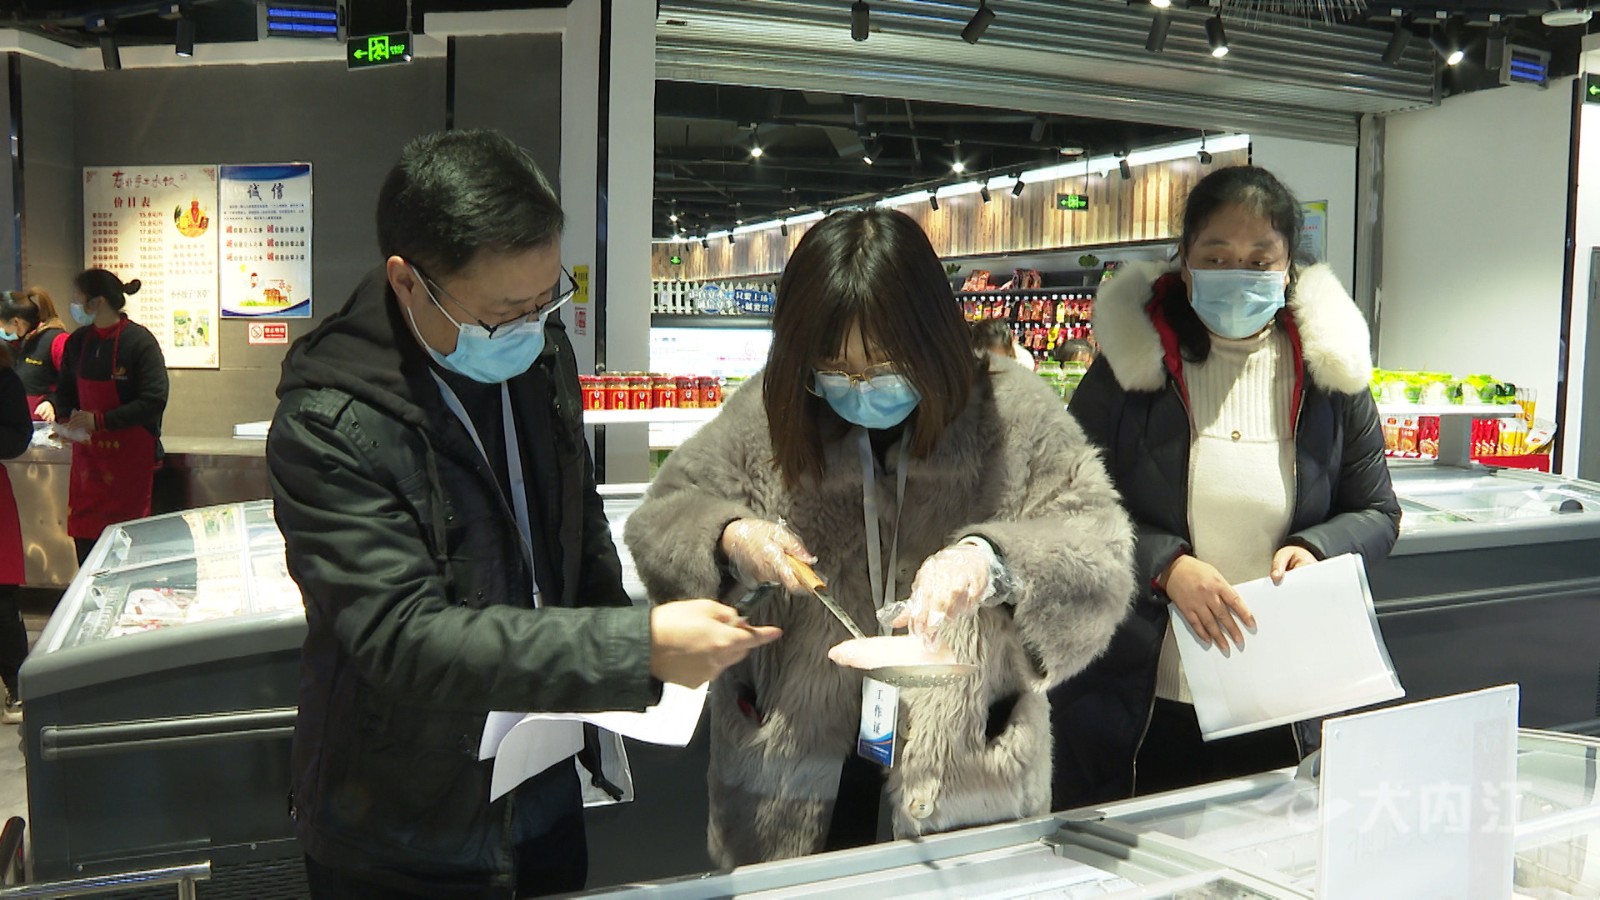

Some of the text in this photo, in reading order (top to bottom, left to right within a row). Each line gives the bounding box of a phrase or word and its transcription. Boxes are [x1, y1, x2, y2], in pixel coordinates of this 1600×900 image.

[247, 183, 285, 201] 诚信
[114, 196, 151, 208] 价目表
